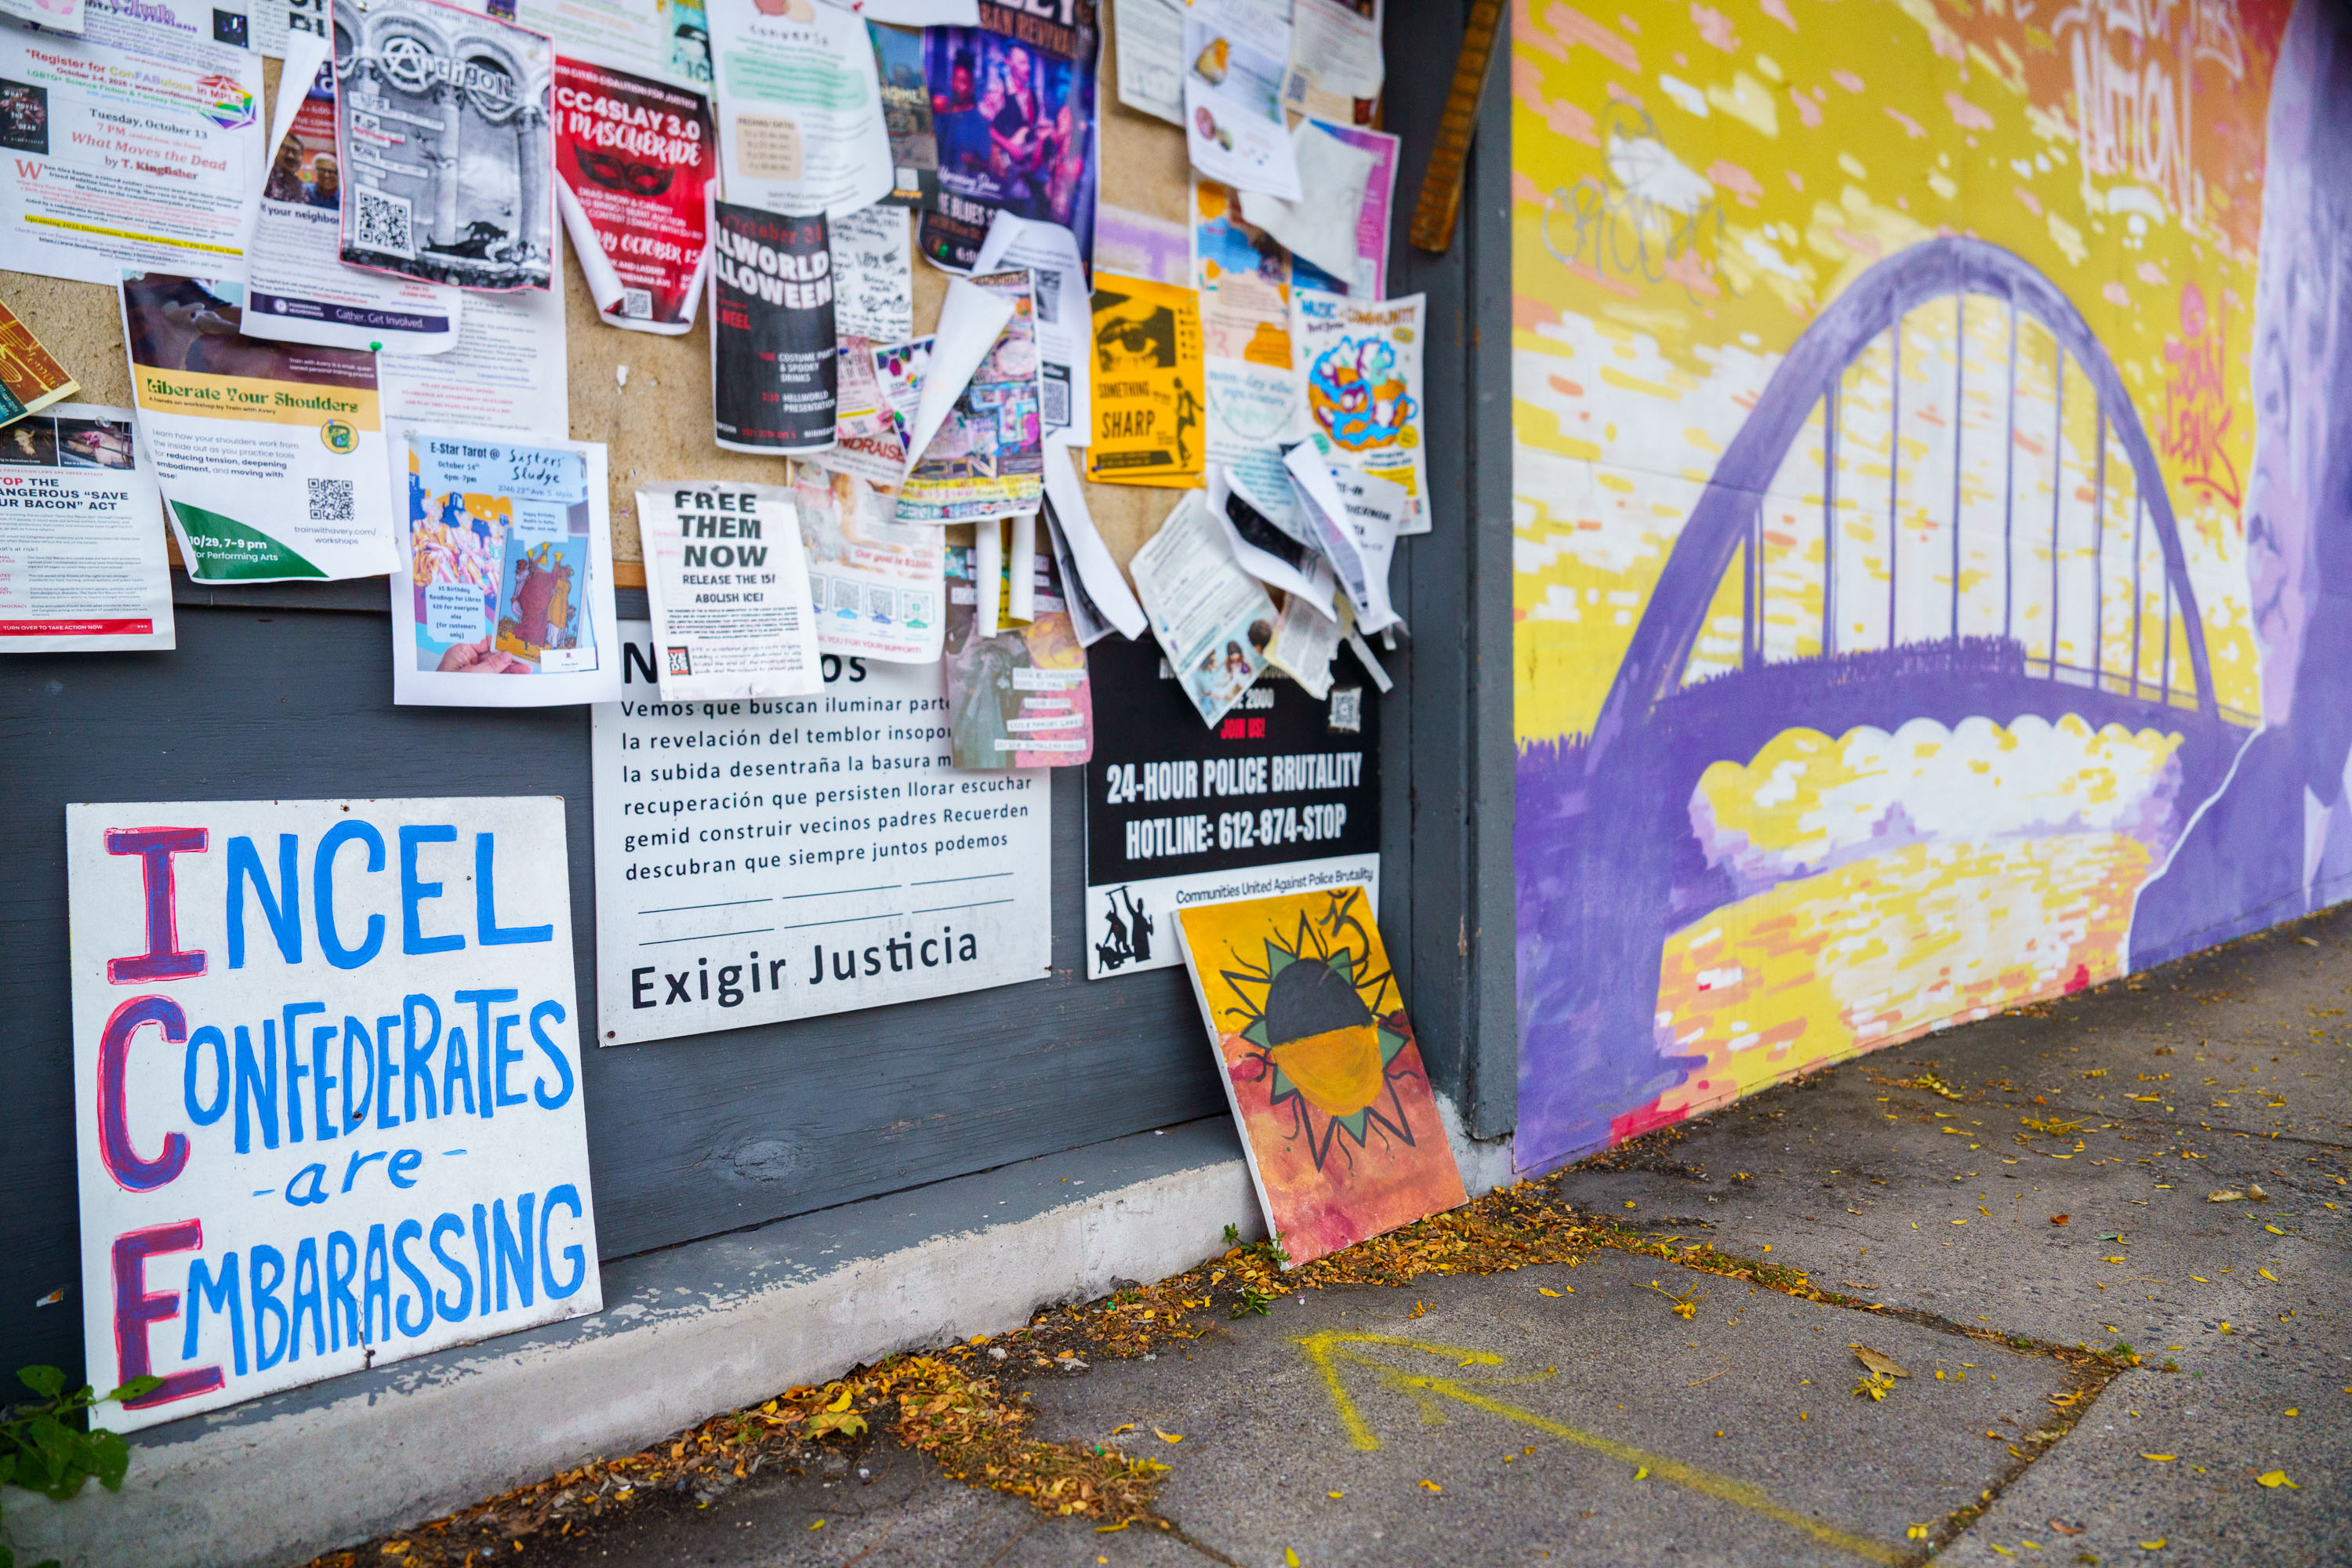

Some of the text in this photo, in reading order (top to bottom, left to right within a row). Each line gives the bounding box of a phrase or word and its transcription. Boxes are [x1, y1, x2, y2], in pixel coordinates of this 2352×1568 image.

[88, 60, 107, 73] for
[196, 86, 207, 96] in
[555, 85, 701, 140] CC4SLAY 3.0
[89, 108, 208, 140] Tuesday, October 13
[96, 122, 126, 136] 7 PM
[569, 111, 702, 167] MASQUERADE
[71, 131, 111, 149] What
[115, 140, 161, 158] Moves
[164, 149, 187, 163] the
[191, 154, 227, 172] Dead
[104, 154, 118, 169] by
[121, 158, 133, 170] T.
[268, 206, 292, 219] your
[336, 309, 367, 323] Gather.
[368, 314, 384, 325] Get
[386, 315, 426, 328] Involved.
[147, 378, 359, 413] Liberate Your Shoulders
[183, 401, 216, 412] workshop
[1102, 410, 1156, 439] SHARP
[153, 439, 166, 448] the
[167, 441, 192, 451] inside
[221, 448, 238, 456] you
[239, 449, 274, 458] practice
[194, 434, 213, 443] your
[216, 437, 257, 446] shoulders
[430, 441, 459, 456] E-Star
[463, 445, 487, 458] Tarot
[490, 448, 500, 460] @
[157, 460, 212, 474] embodiment,
[230, 468, 263, 478] moving
[265, 470, 284, 478] with
[166, 452, 288, 470] reducing tension, deepening
[438, 460, 465, 470] October
[28, 478, 60, 487] THE
[511, 466, 561, 485] Sludge
[0, 488, 80, 499] ANGEROUS
[0, 499, 19, 507] UR
[89, 502, 118, 510] ACT
[674, 490, 757, 514] FREE
[294, 525, 376, 537] trainwithavery.com/
[677, 514, 762, 539] THEM
[189, 535, 223, 550] 10/29,
[247, 540, 267, 551] pm
[314, 537, 359, 546] workshops
[207, 550, 259, 563] Performing
[260, 553, 279, 561] Arts
[684, 545, 768, 568] NOW
[683, 573, 775, 585] RELEASE THE 15!
[695, 593, 764, 604] ABOLISH ICE!
[621, 696, 949, 720] Vemos que buscan iluminar part
[1245, 688, 1275, 709] 2000
[622, 732, 641, 750] la
[650, 728, 760, 749] revelación
[769, 728, 799, 745] del
[806, 724, 881, 743] temblor
[1220, 717, 1266, 739] JOIN US!
[623, 765, 641, 782] la
[651, 762, 720, 782] subida
[730, 757, 840, 778] desentraña
[848, 756, 865, 771] la
[872, 754, 931, 771] basura
[1105, 751, 1363, 805] 24-HOUR POLICE BRUTALITY
[624, 775, 1032, 816] recuperación que persisten llorar escuchar
[624, 804, 1029, 853] gemid construir vecinos padres Recuerden
[1126, 803, 1348, 861] HOTLINE: 612-874-STOP
[626, 833, 1008, 881] descubran que siempre juntos podemos
[1176, 866, 1374, 904] Communities United Against Police Brutality
[103, 819, 554, 985] INCEL
[630, 926, 979, 1010] Exigir Justicia
[96, 987, 575, 1193] CONFEDERATES
[111, 1183, 586, 1411] EMBARASSING
